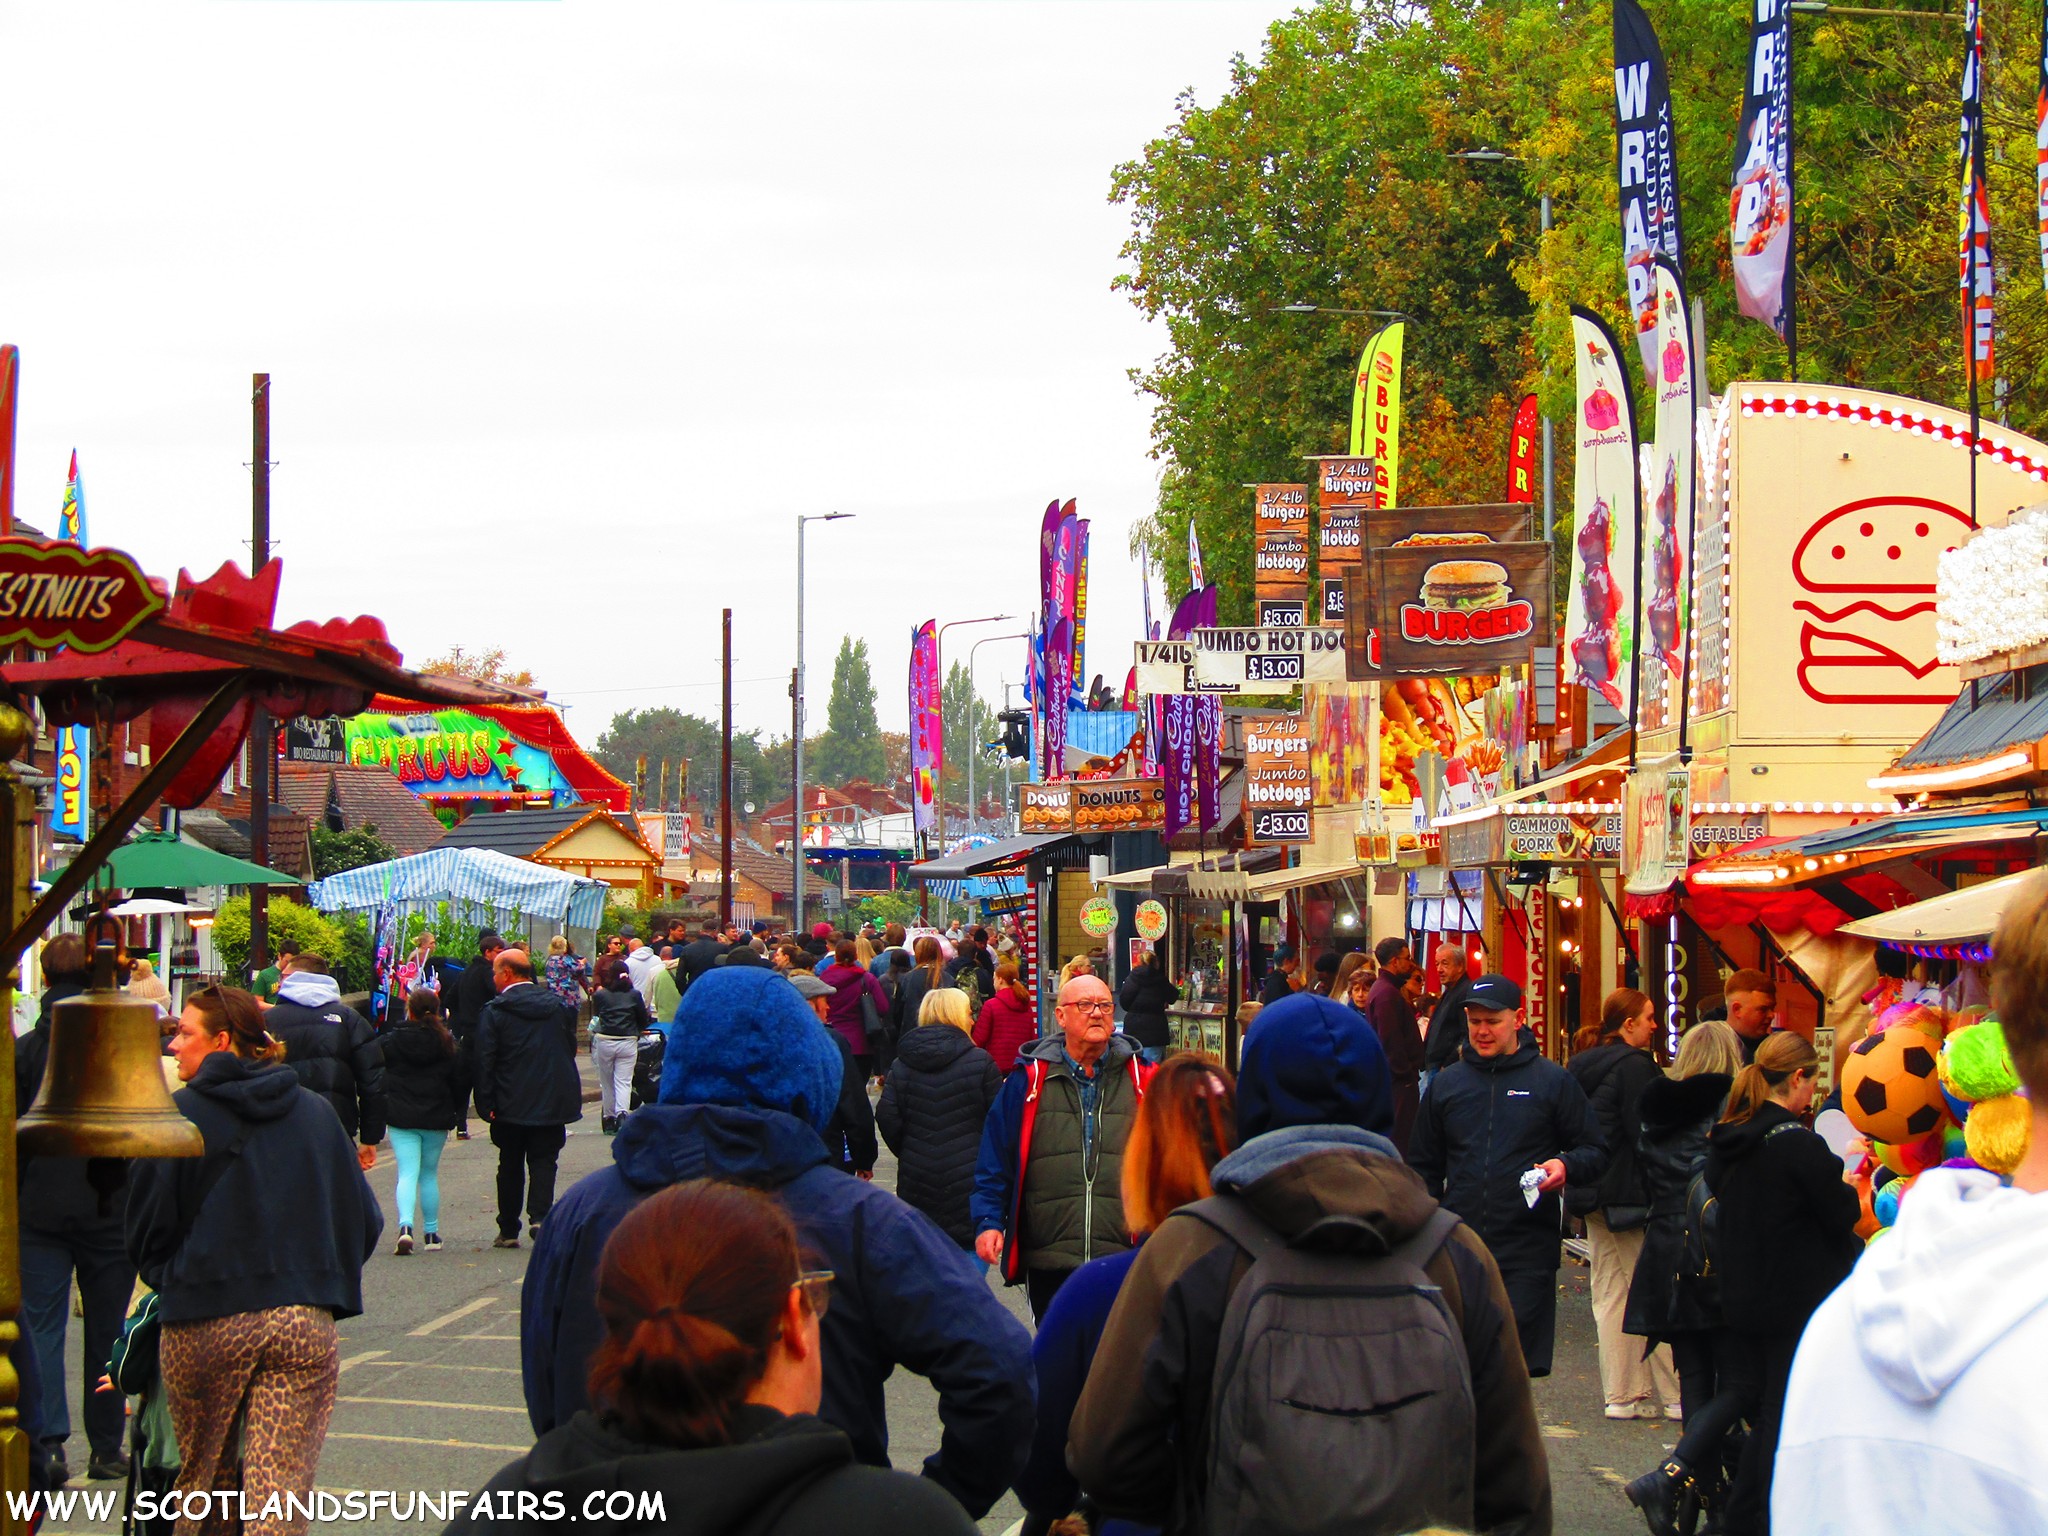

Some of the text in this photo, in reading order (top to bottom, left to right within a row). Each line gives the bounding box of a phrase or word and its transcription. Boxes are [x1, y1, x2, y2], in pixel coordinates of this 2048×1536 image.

[1614, 60, 1650, 321] WRAP
[1327, 462, 1370, 478] 1/4lb
[1515, 435, 1529, 503] FR
[1325, 477, 1373, 496] Burgers
[1264, 491, 1303, 504] 1/4lb
[1260, 504, 1306, 523] Burgers
[1261, 540, 1302, 552] Jumbo
[1257, 553, 1307, 574] Hotdogs
[1403, 602, 1531, 642] BURGER
[1197, 631, 1261, 652] JUMBO
[1268, 631, 1305, 651] HOT
[1140, 644, 1192, 664] 1/4lb
[1248, 656, 1298, 680] £3.00
[1047, 677, 1062, 752] Cadbury
[1256, 719, 1298, 734] 1/4lb
[1247, 734, 1308, 757] Burgers
[351, 729, 491, 782] CIRCUS
[1252, 764, 1306, 780] Jumbo
[1248, 783, 1312, 807] Hotdogs
[1472, 781, 1494, 794] Cips
[1027, 792, 1071, 807] DONU
[1078, 789, 1141, 806] DONUTS
[1179, 779, 1189, 823] HOT
[1256, 815, 1307, 835] £3.00
[1508, 817, 1570, 833] GAMMON
[1517, 836, 1555, 851] PORK
[1084, 900, 1112, 912] FRESH
[1140, 903, 1163, 915] FRESH
[1082, 916, 1117, 934] DONUTS
[1137, 918, 1165, 937] DONUTS
